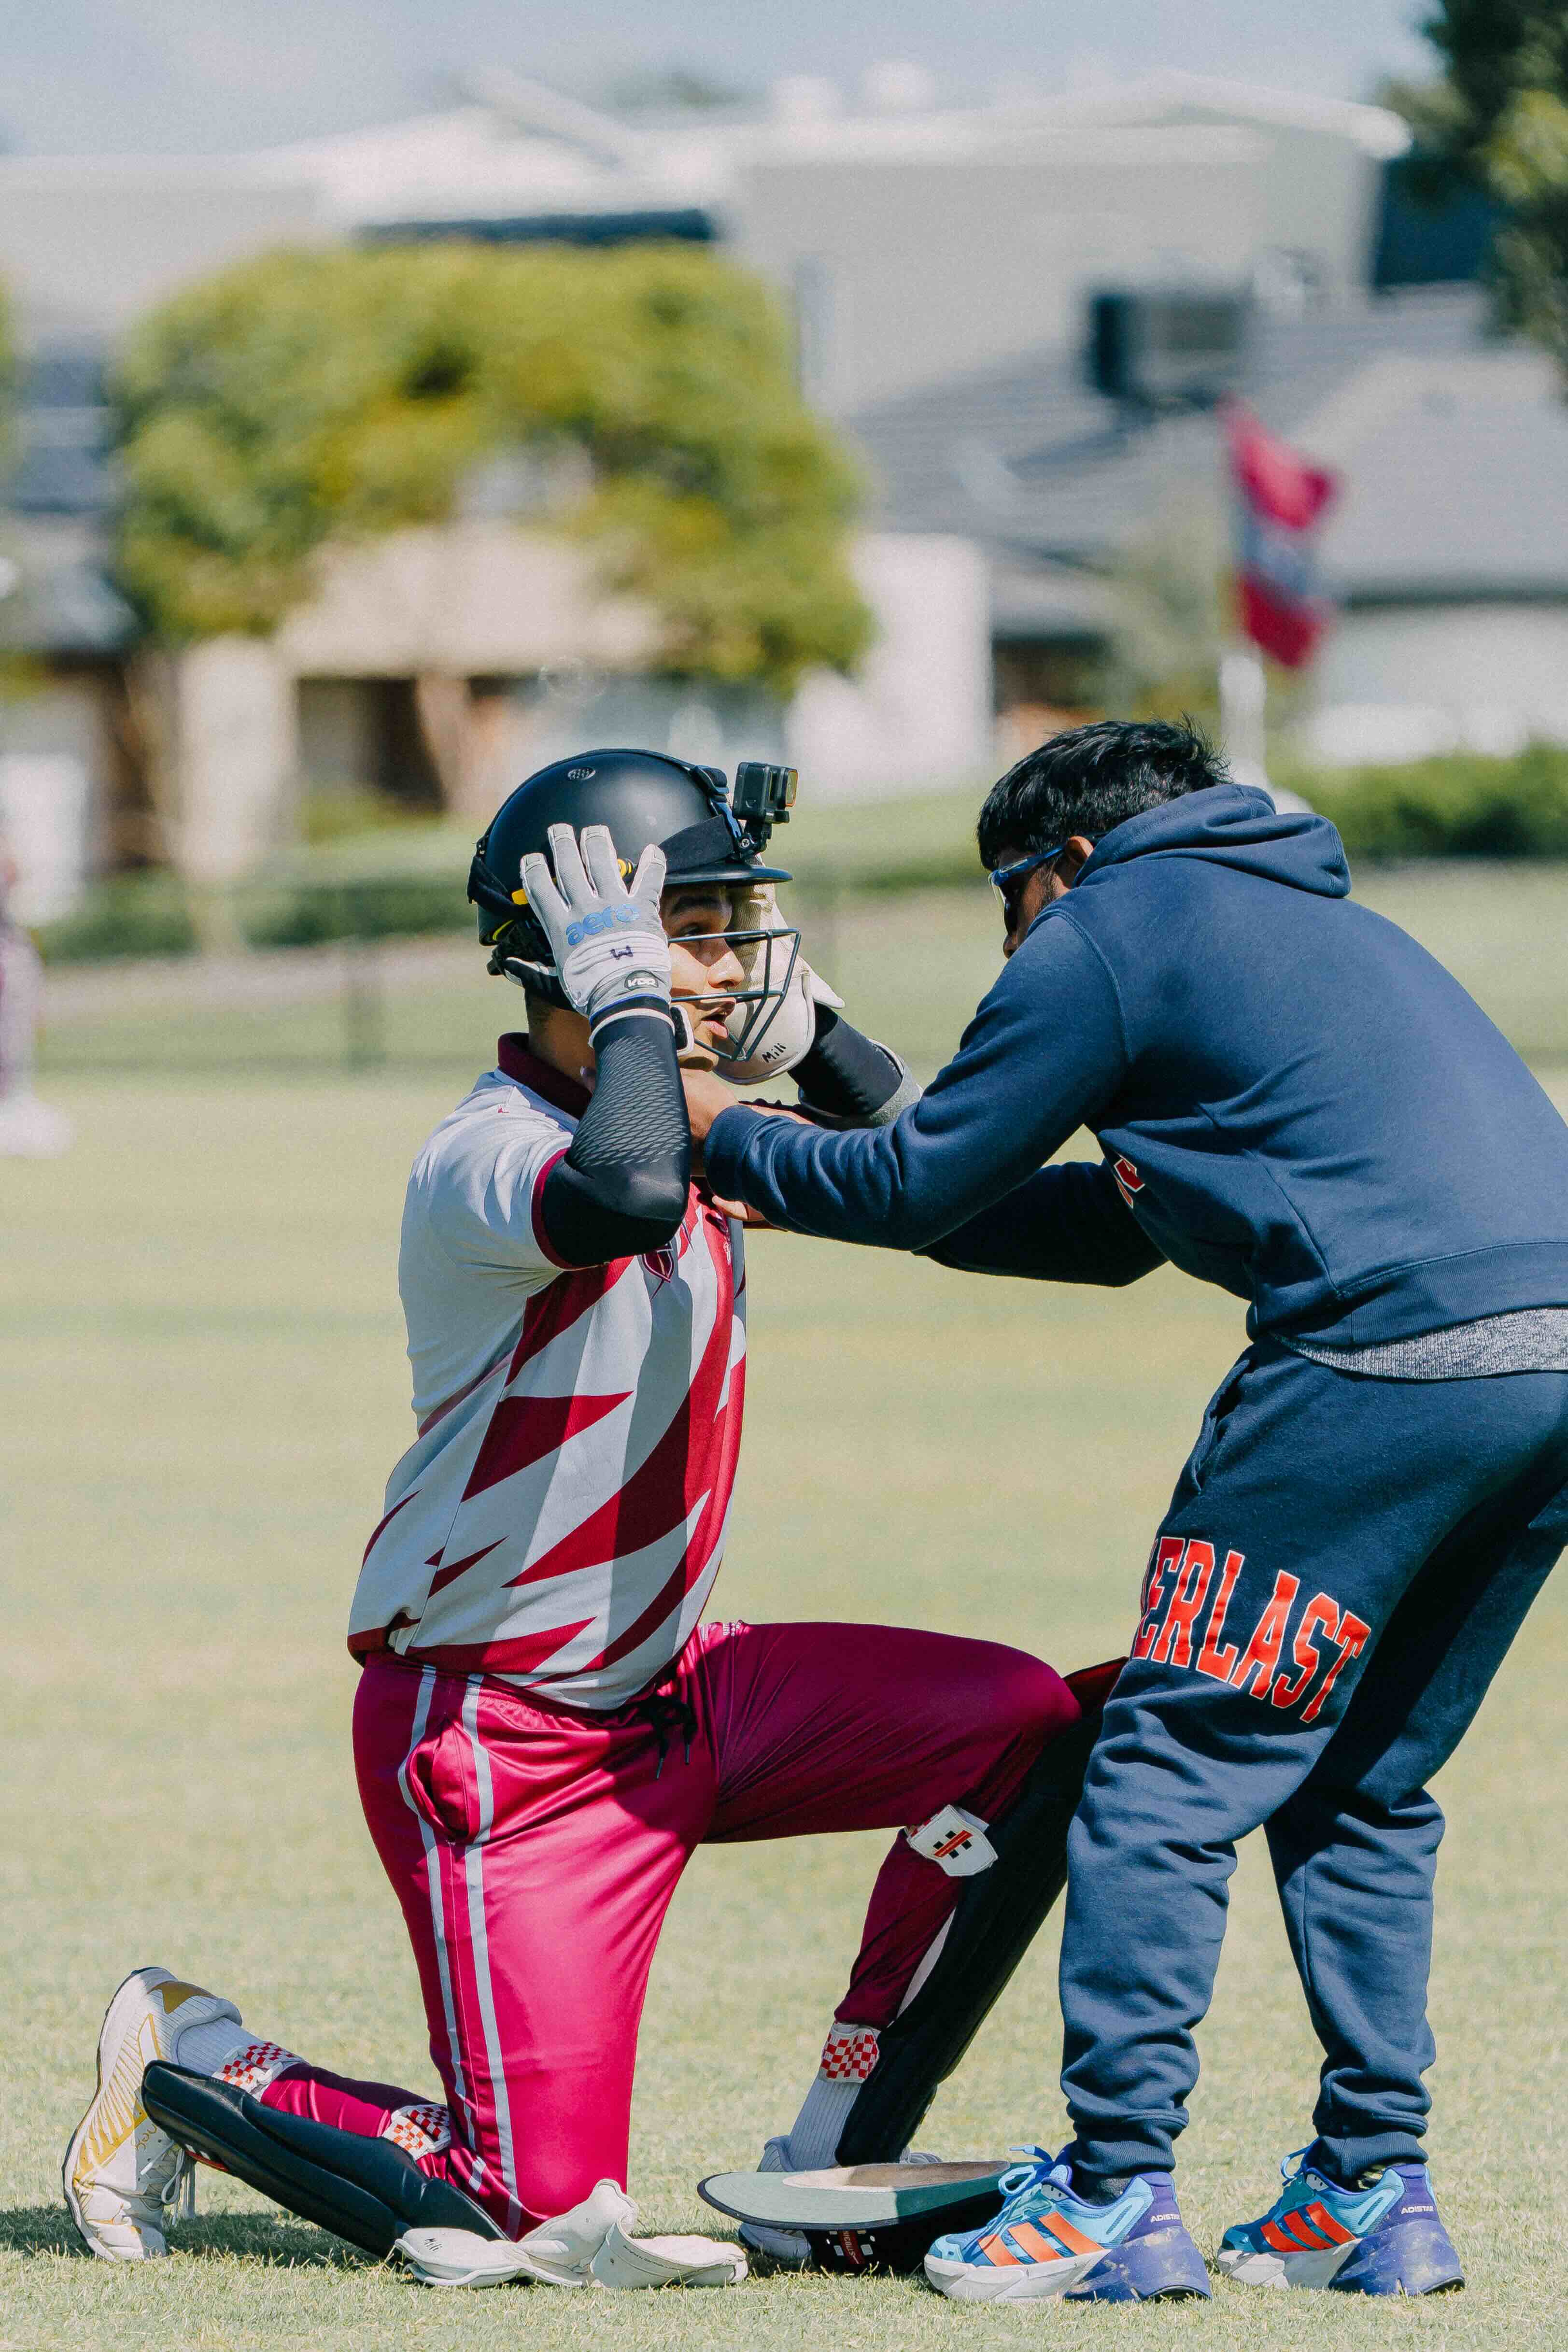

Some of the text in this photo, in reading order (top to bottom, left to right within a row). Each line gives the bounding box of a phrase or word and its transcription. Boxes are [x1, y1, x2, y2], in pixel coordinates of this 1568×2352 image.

[565, 904, 641, 946] aero
[762, 1043, 786, 1063] Mili
[1130, 1536, 1371, 1723] ERLAST
